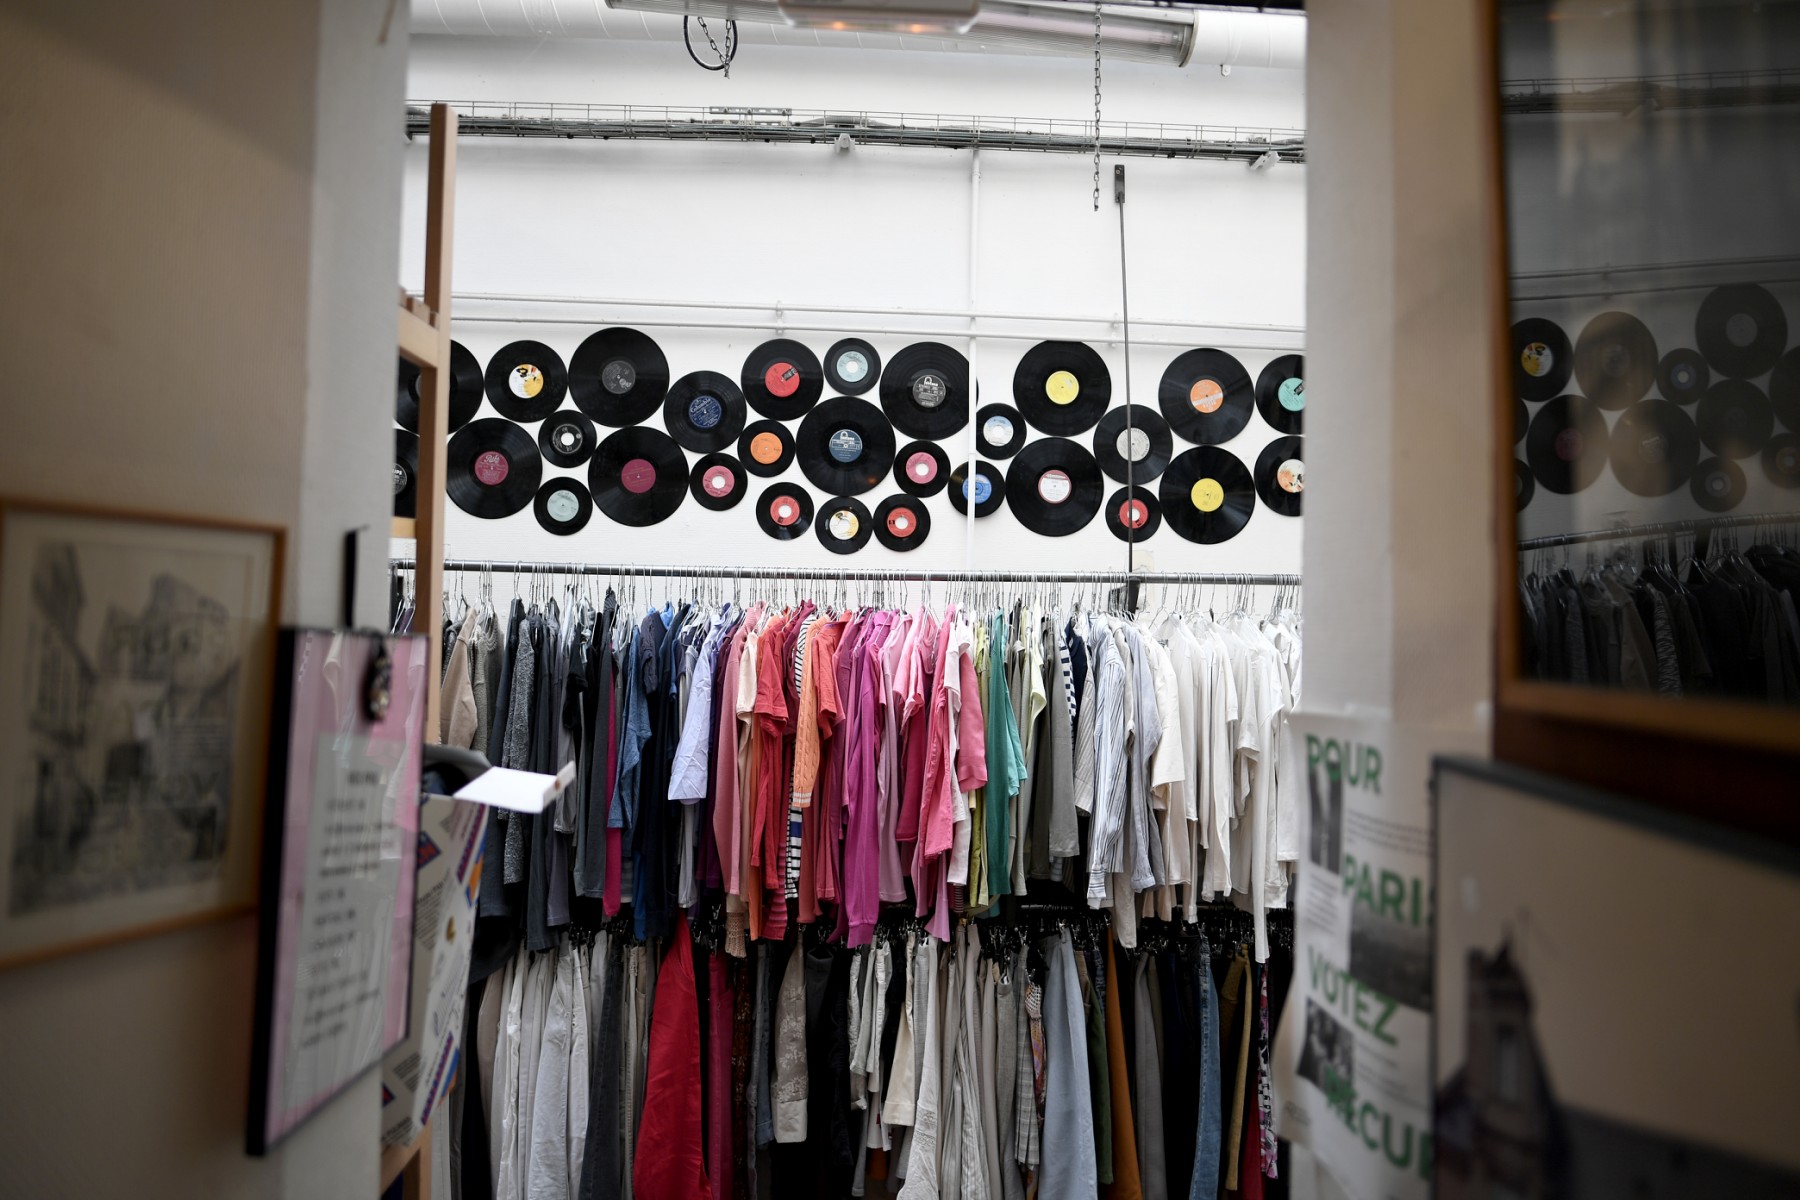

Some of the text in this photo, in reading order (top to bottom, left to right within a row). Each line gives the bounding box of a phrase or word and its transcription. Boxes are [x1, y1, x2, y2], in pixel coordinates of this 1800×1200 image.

[1305, 733, 1383, 795] POUR
[1342, 853, 1434, 929] PARI
[1307, 944, 1399, 1047] VOTEZ
